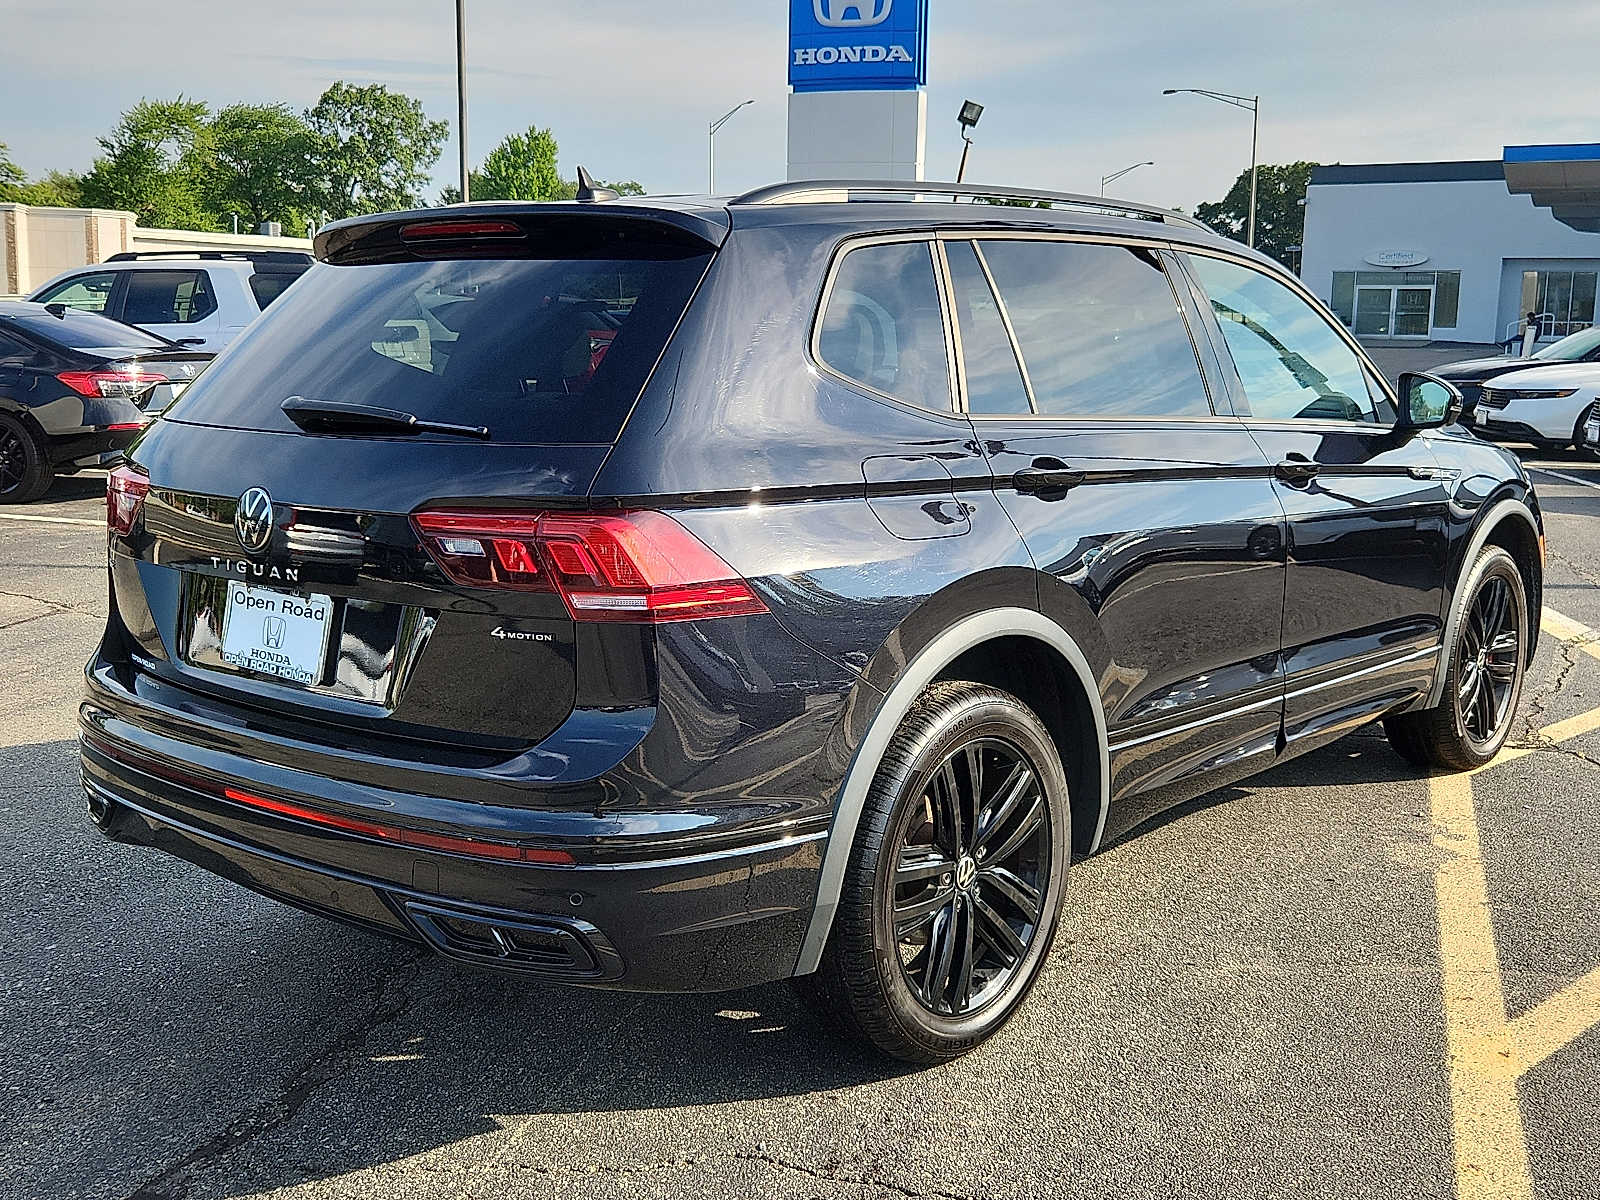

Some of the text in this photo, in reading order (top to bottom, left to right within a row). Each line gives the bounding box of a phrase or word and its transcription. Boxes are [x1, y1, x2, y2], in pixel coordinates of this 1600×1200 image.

[793, 45, 914, 65] HONDA
[210, 556, 299, 582] TIGUAN
[234, 590, 276, 612] Open
[281, 599, 325, 621] Road
[490, 626, 553, 641] 4MOTION
[223, 652, 313, 684] OPEN ROAD HONDA
[250, 648, 292, 666] HONDA
